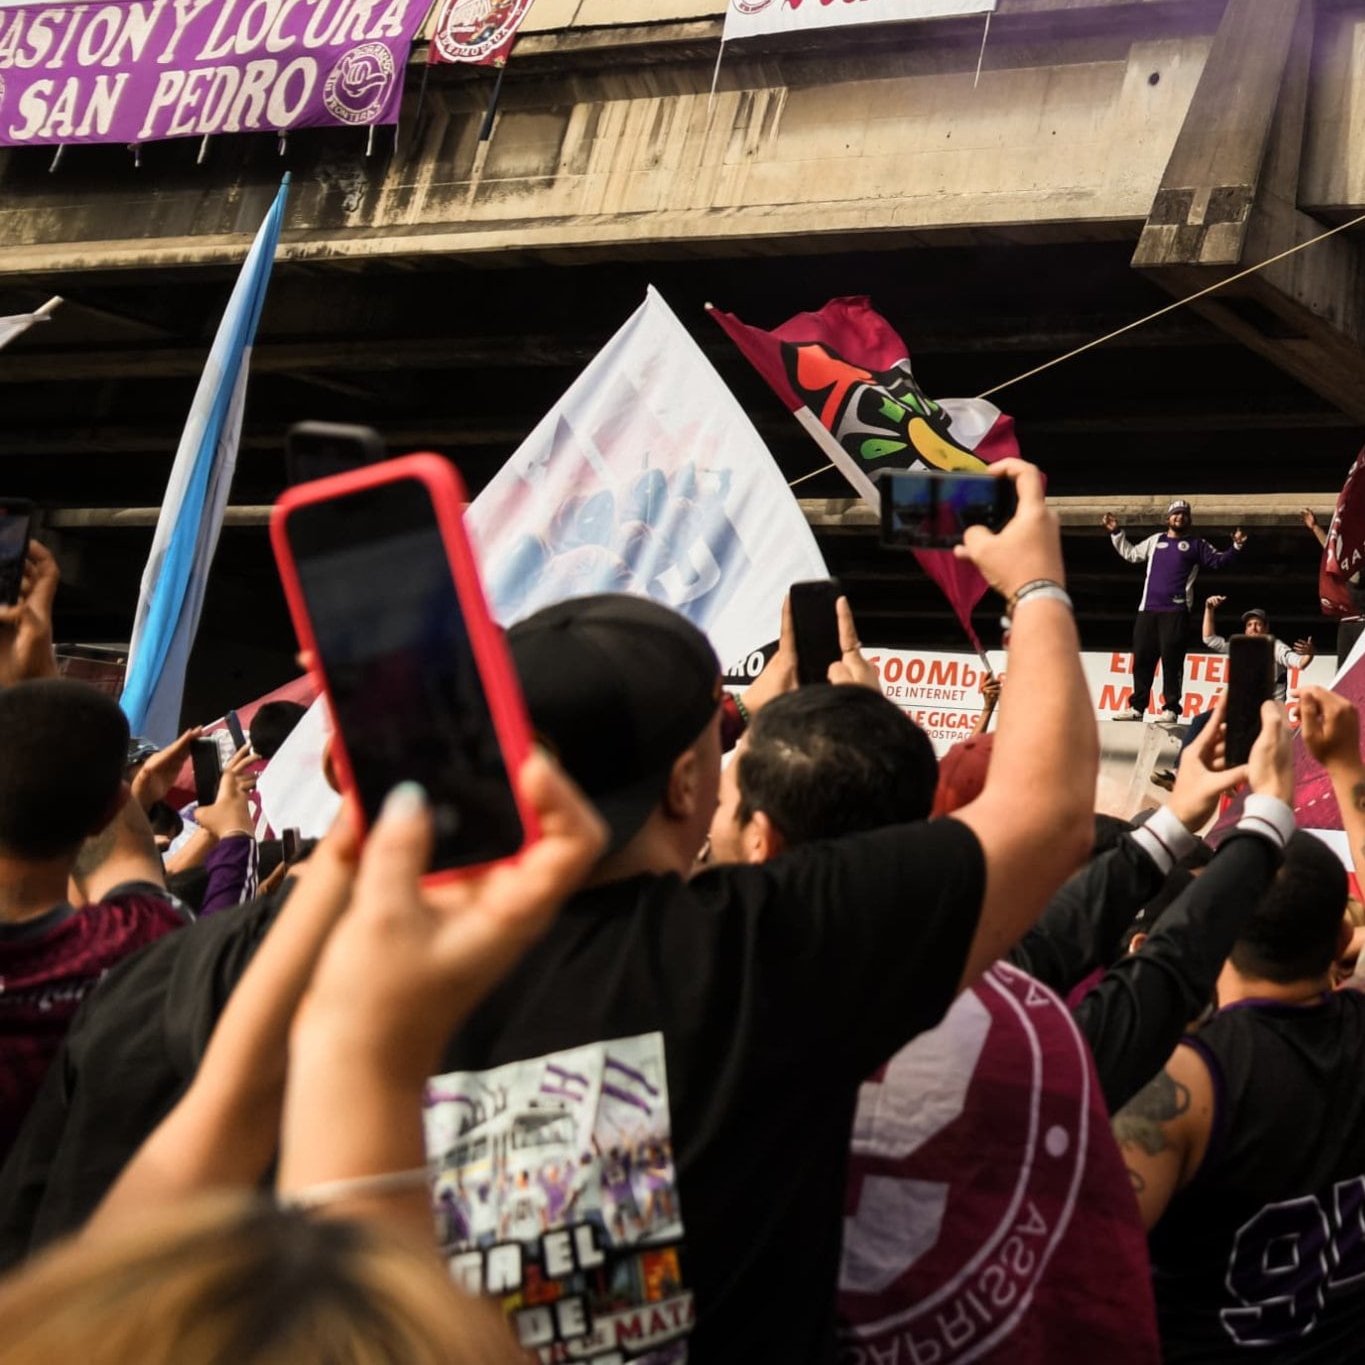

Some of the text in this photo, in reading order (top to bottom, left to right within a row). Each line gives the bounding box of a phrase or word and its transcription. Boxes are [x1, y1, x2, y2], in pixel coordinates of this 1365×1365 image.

[9, 73, 130, 140] SAN
[137, 56, 318, 139] PEDRO
[886, 685, 966, 701] DE INTERNET
[928, 711, 980, 730] GIGAS
